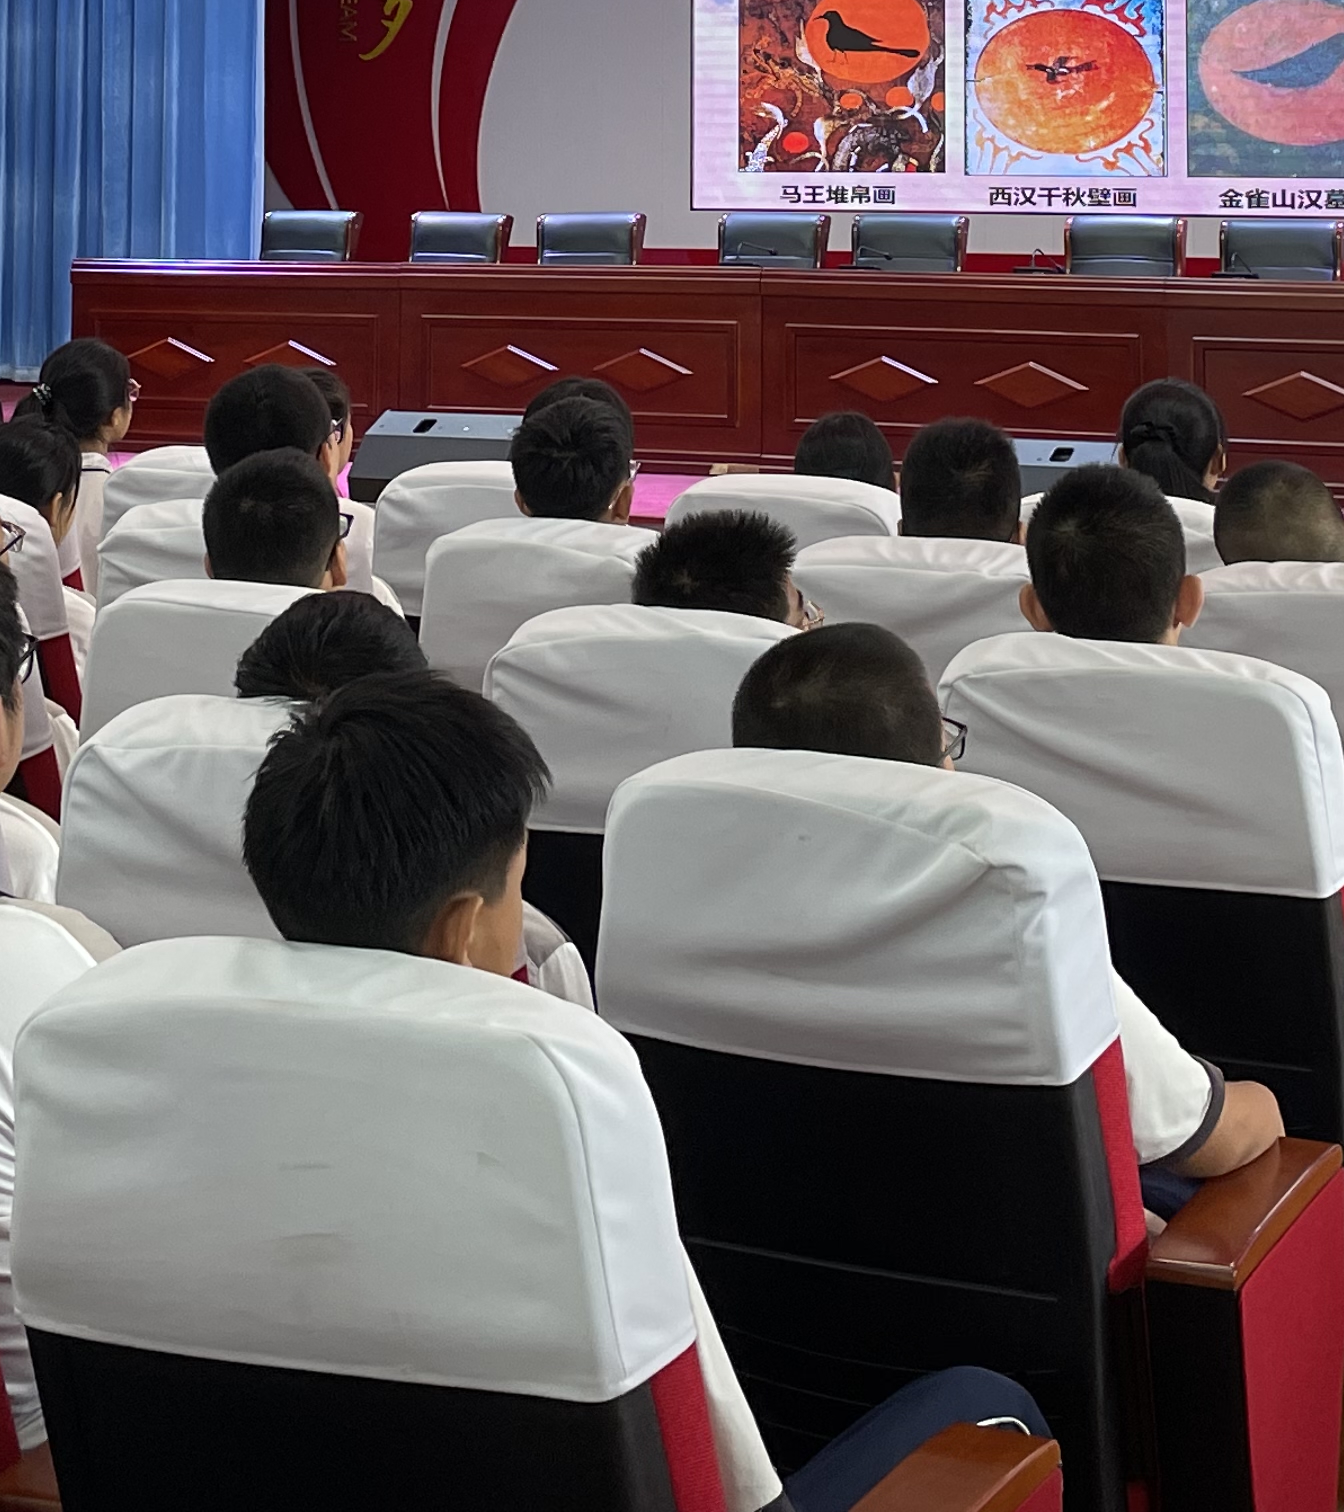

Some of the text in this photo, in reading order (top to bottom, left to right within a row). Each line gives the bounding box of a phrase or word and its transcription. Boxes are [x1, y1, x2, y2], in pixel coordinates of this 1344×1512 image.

[779, 184, 896, 207] 马王堆帛画
[988, 186, 1138, 208] 西汉千秋壁画
